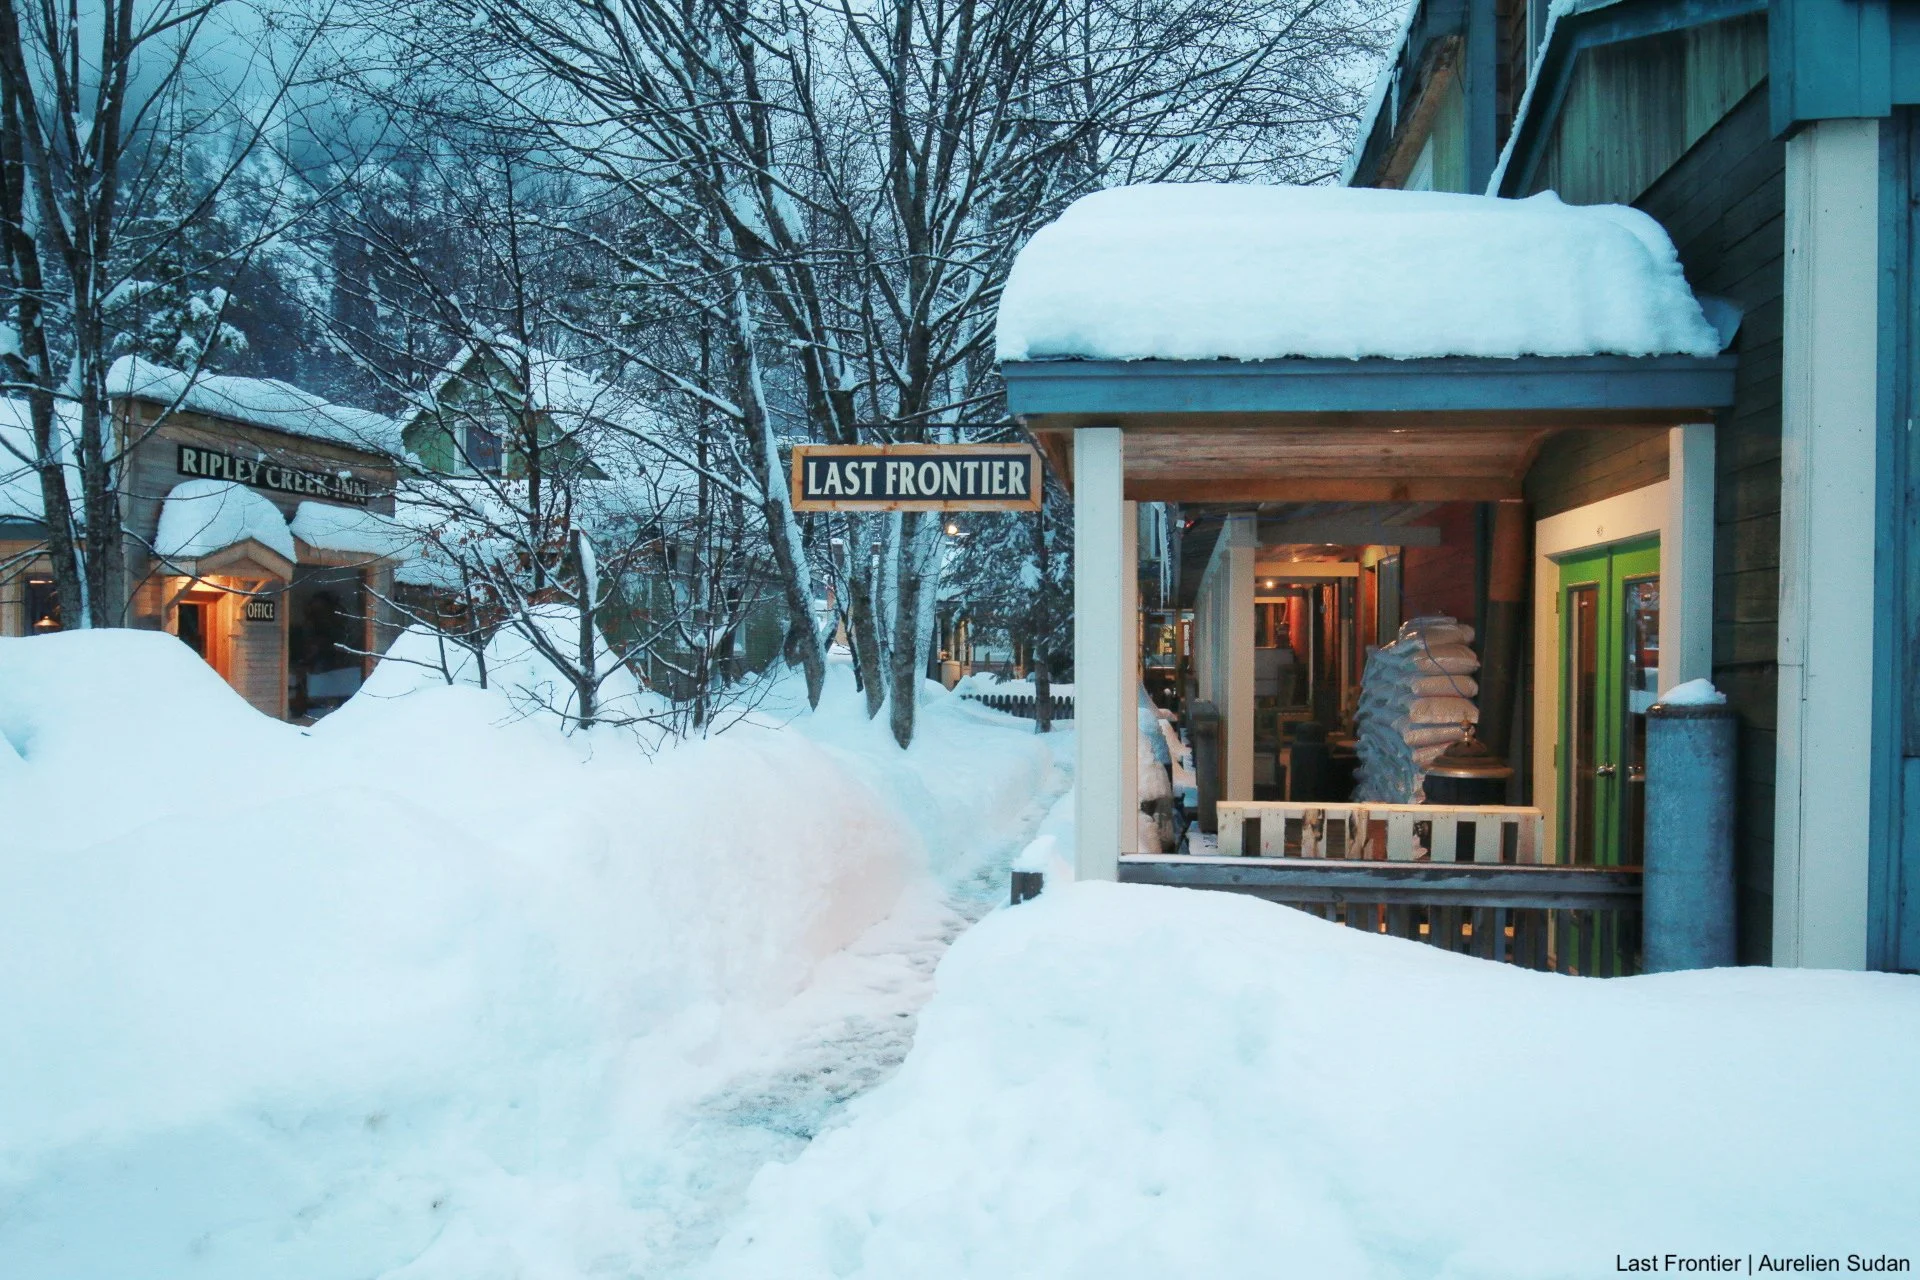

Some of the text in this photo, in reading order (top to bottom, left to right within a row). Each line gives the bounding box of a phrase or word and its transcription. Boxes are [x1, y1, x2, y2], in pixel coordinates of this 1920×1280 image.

[182, 448, 366, 503] RIPLEY CREEK INN
[808, 461, 1026, 496] LAST FRONTIER
[247, 602, 274, 619] OFFICE
